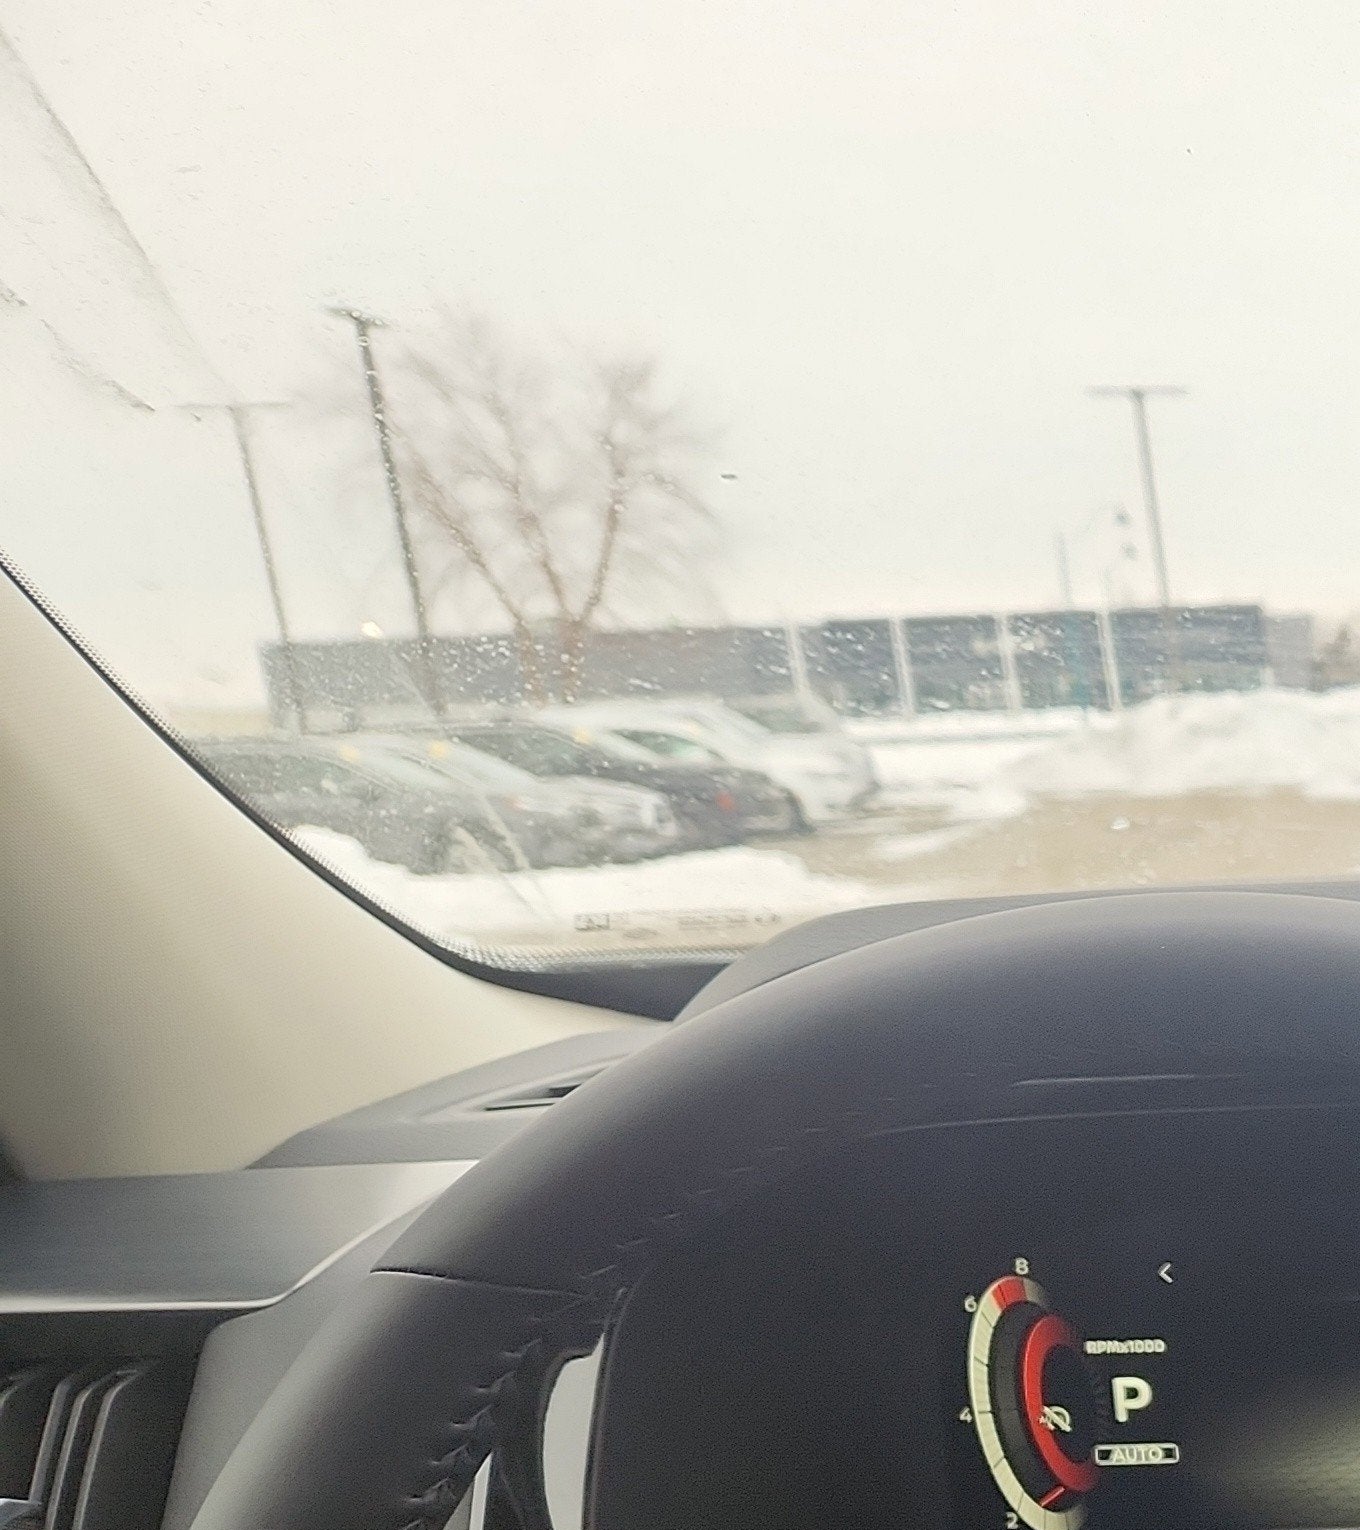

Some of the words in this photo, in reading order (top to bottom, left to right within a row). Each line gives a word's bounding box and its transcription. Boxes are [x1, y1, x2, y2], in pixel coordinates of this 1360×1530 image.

[1015, 1257, 1029, 1275] 8
[964, 1296, 977, 1312] 6
[1111, 1376, 1152, 1422] P
[959, 1409, 973, 1424] 4
[1110, 1446, 1163, 1463] AUTO
[1006, 1511, 1019, 1530] 2
